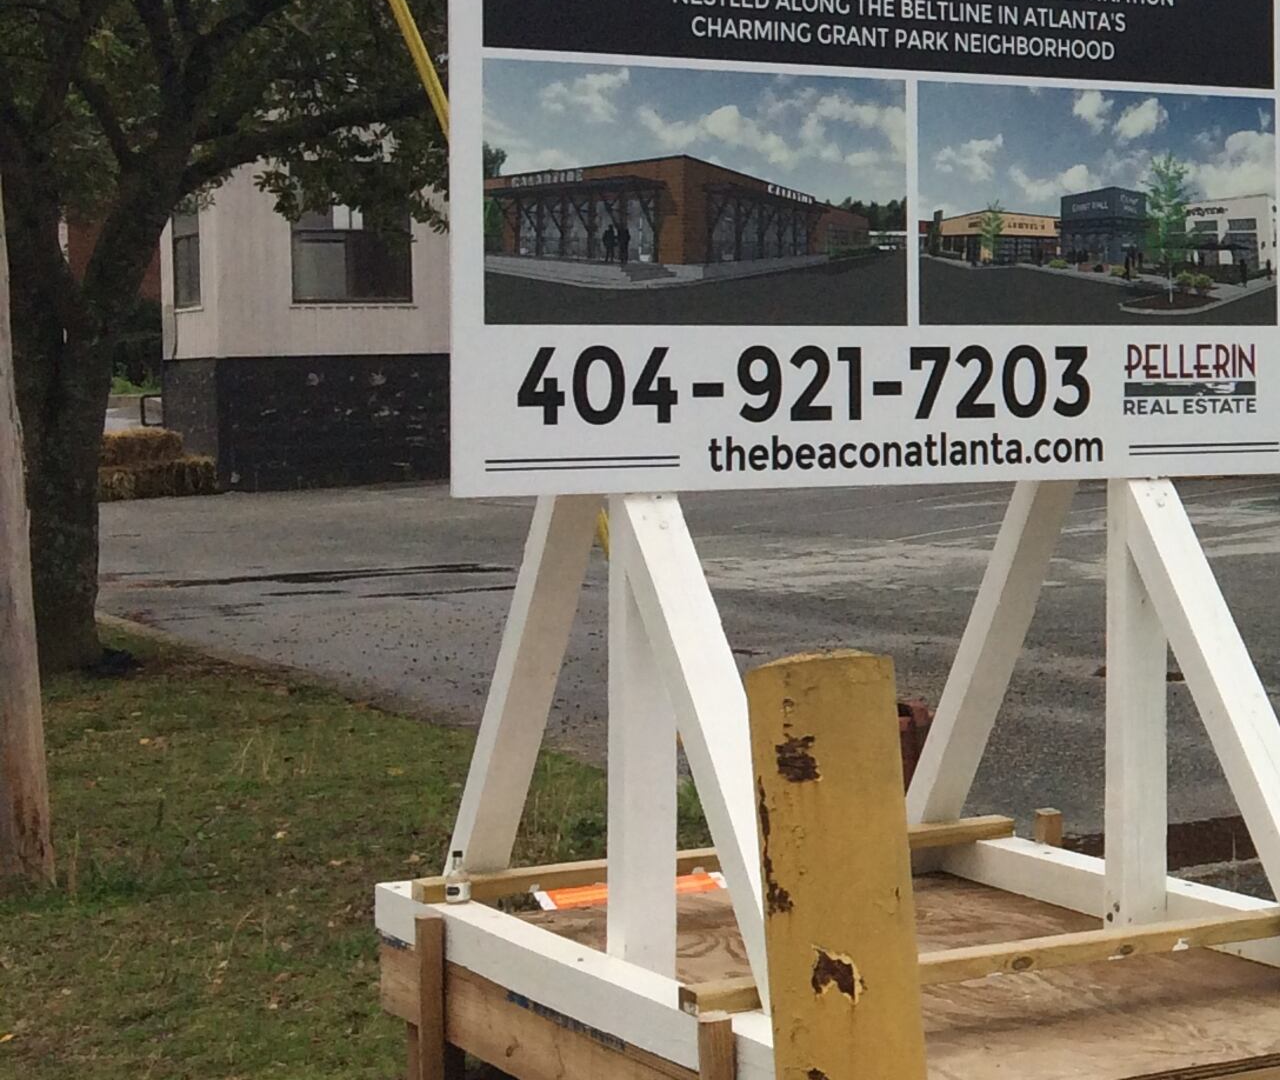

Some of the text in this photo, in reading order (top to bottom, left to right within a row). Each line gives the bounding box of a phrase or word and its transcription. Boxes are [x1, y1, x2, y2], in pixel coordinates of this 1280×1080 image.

[998, 5, 1018, 26] IN
[1023, 7, 1126, 32] ATLANTA'S
[691, 16, 1116, 61] CHARMING GRANT PARK NEIGHBORHOOD
[1124, 344, 1256, 379] PELLERIN
[517, 344, 1092, 426] 404-921-7203
[1123, 398, 1257, 415] REAL ESTATE
[708, 431, 1104, 473] thebeaconatlanta.com
